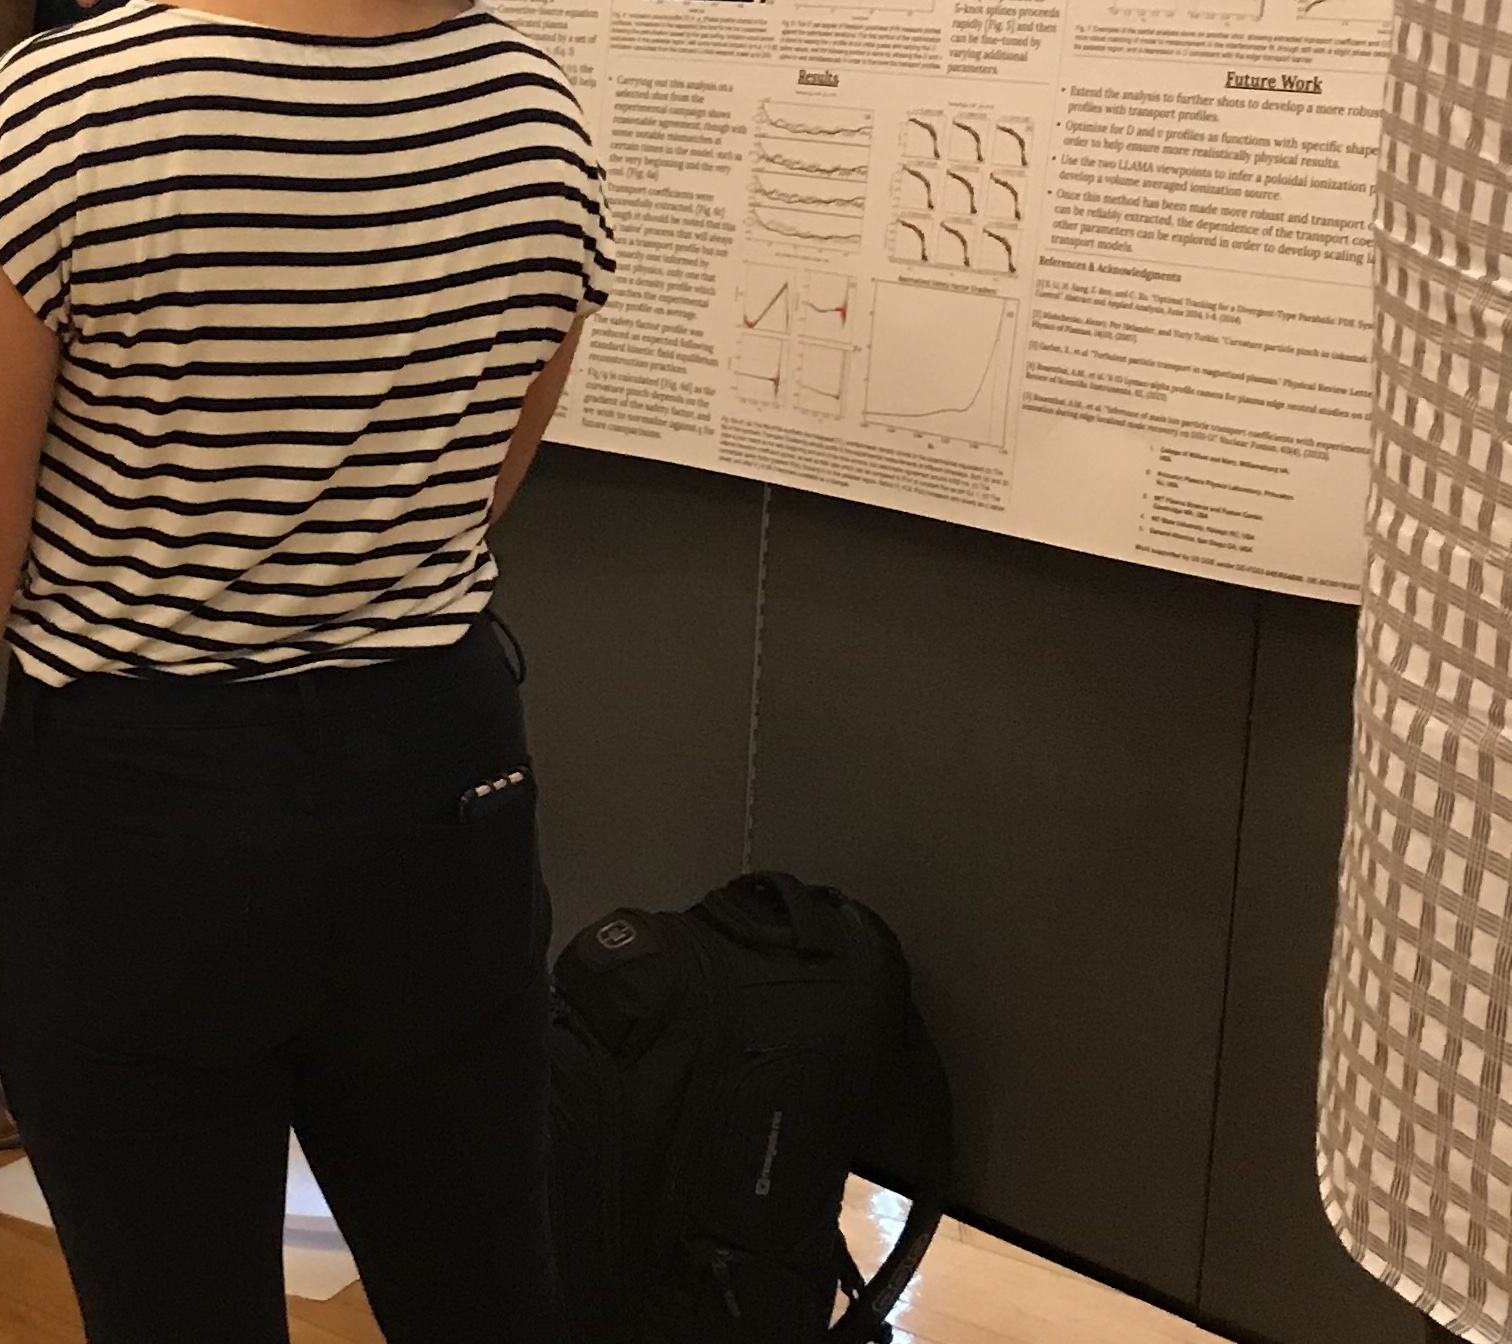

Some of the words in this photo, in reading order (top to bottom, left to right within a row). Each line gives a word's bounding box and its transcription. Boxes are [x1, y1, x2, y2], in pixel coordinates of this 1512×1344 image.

[798, 69, 839, 86] Results
[1226, 71, 1276, 89] Future
[1281, 74, 1323, 92] Work
